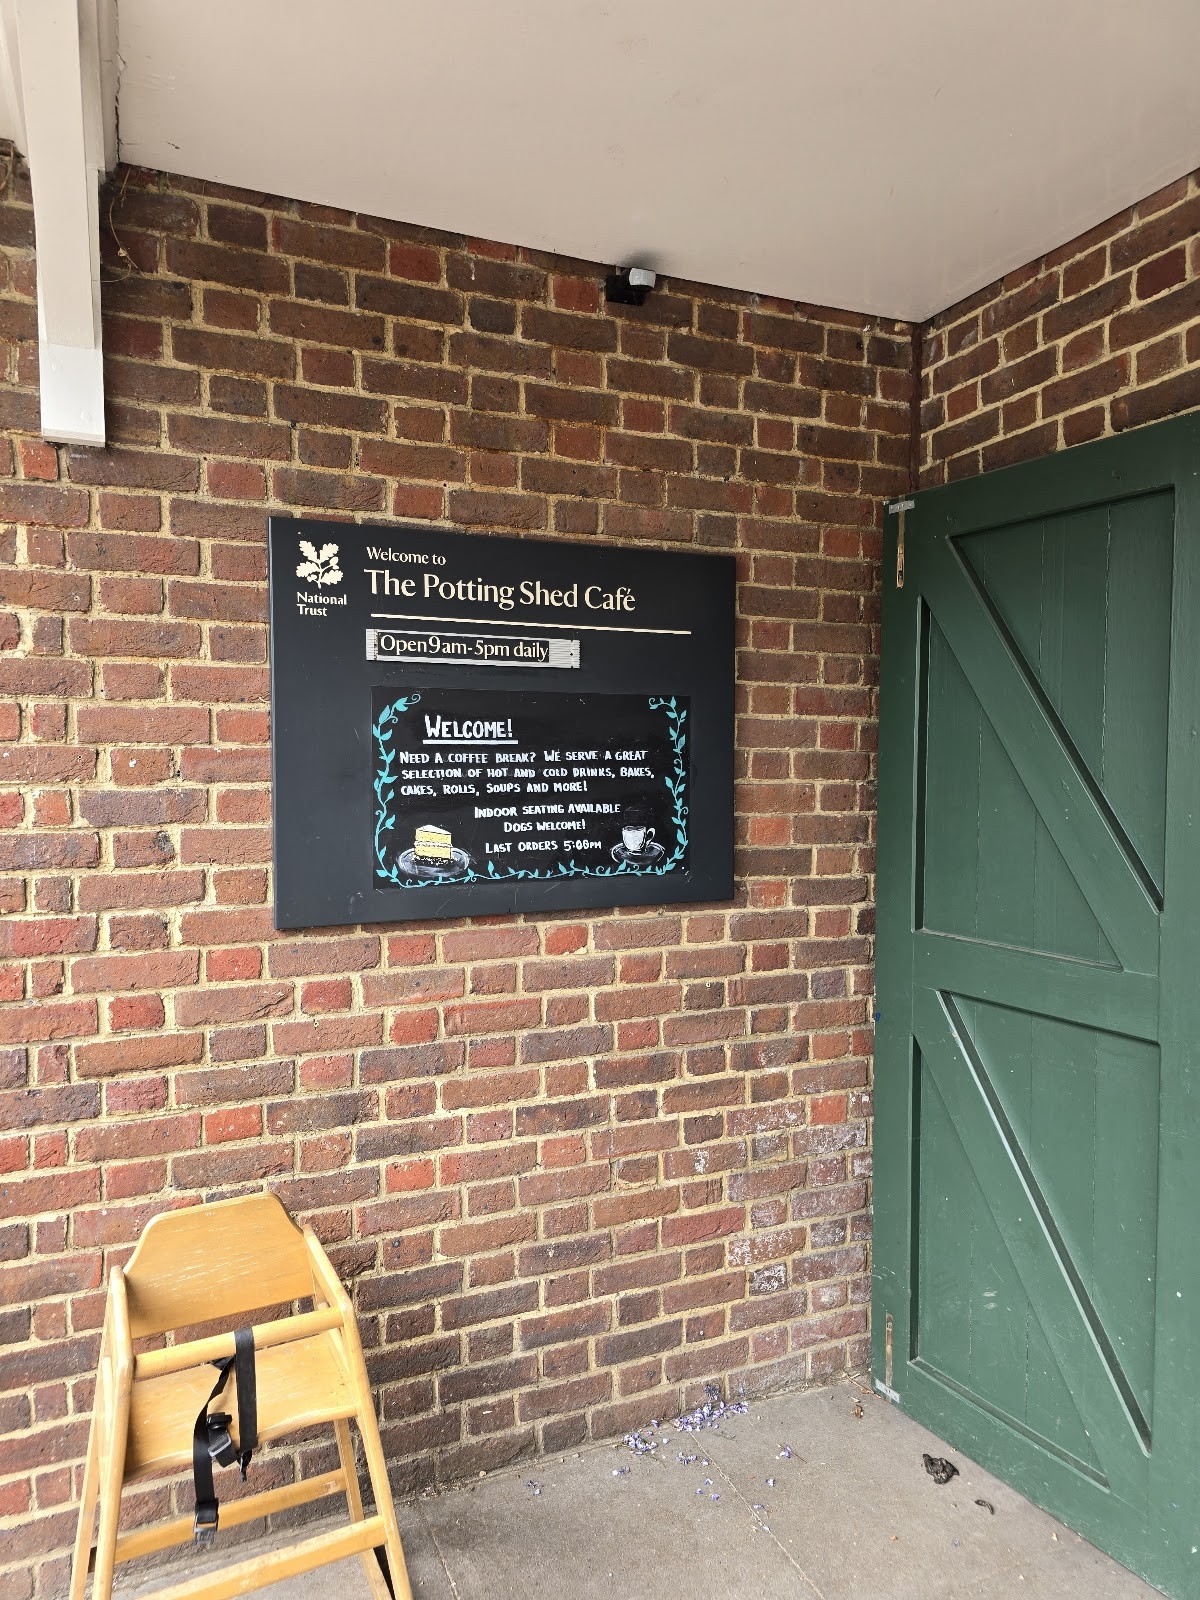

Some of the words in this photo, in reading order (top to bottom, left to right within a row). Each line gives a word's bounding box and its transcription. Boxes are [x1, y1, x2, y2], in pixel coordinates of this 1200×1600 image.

[366, 546, 429, 564] Welcome
[432, 553, 447, 566] to
[363, 568, 417, 597] The
[423, 573, 514, 611] Potting
[520, 580, 578, 608] Shed
[584, 586, 636, 611] Café
[296, 591, 347, 606] National
[296, 603, 328, 617] Trust
[513, 642, 549, 662] daily
[424, 714, 513, 739] WELCOME!
[399, 751, 430, 764] NEED
[434, 752, 444, 764] A
[448, 753, 489, 764] COFFEE
[495, 751, 537, 763] BREAK?
[543, 749, 561, 762] WE
[565, 750, 599, 761] SERVE
[604, 750, 613, 761] A
[614, 750, 649, 761] GREAT
[401, 768, 462, 780] SELECTION
[467, 768, 484, 778] OF
[487, 768, 509, 778] HOT
[513, 767, 536, 778] AND
[542, 768, 569, 778] COLD
[572, 767, 616, 779] DRINKS,
[620, 767, 655, 779] BAKES,
[400, 784, 437, 797] CAKES,
[442, 784, 480, 797] ROLLS,
[486, 782, 521, 794] SOUPS
[526, 782, 549, 793] AND
[553, 781, 588, 793] MORE!
[474, 806, 518, 819] INDOOR
[522, 804, 565, 815] SEATING
[567, 803, 621, 814] AVAILABLE
[503, 821, 533, 833] DOGS
[536, 818, 586, 831] WELCOME!
[485, 842, 513, 854] LAST
[517, 840, 559, 852] ORDERS
